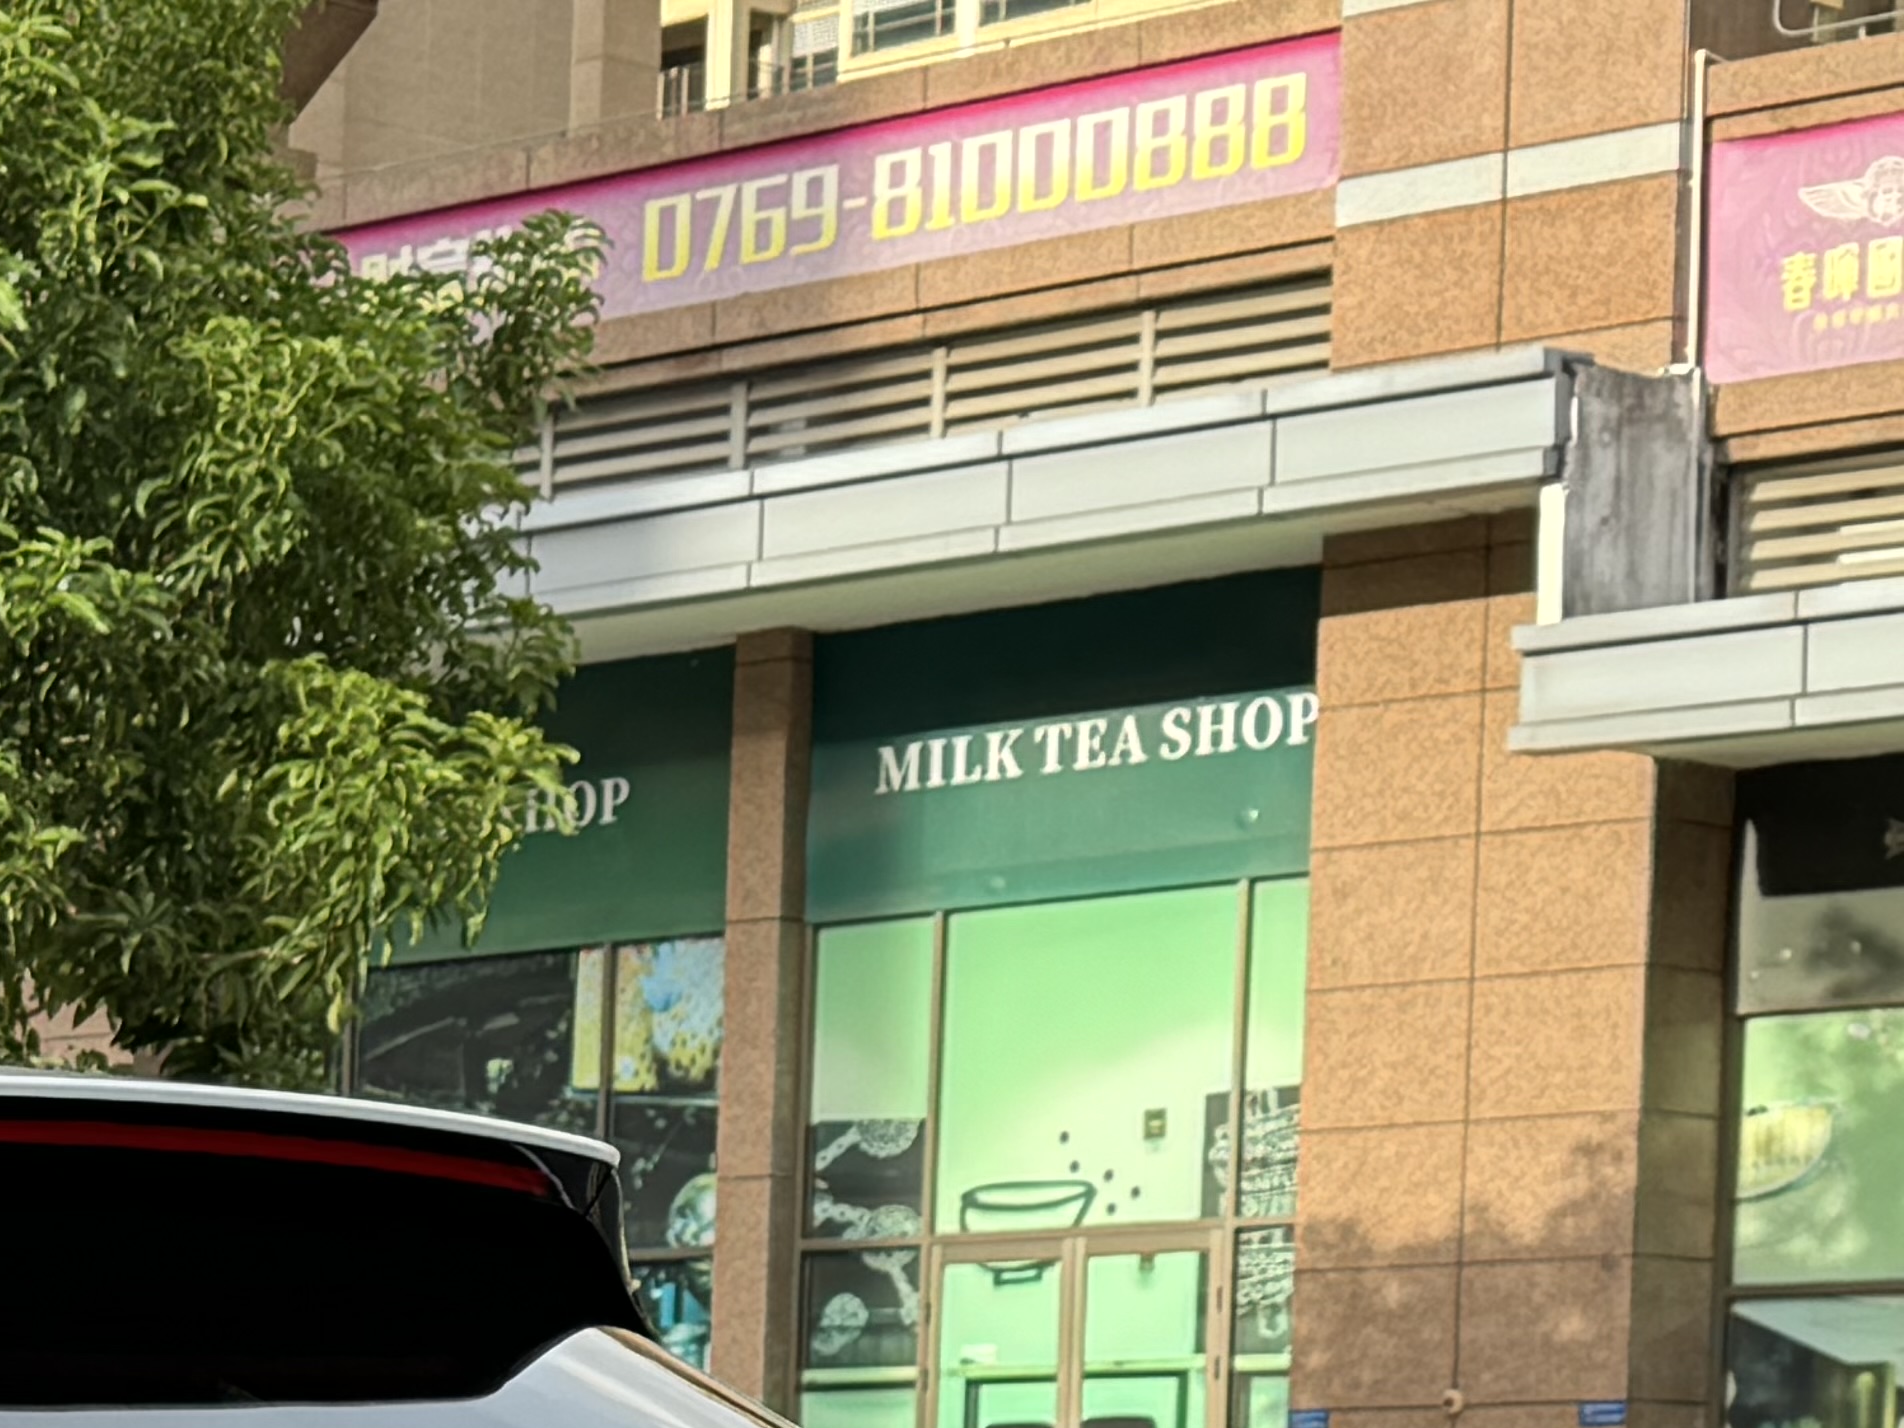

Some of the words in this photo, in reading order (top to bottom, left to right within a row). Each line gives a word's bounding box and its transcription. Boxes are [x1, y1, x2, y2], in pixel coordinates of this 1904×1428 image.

[641, 71, 1307, 282] 0769-81000888
[874, 728, 1024, 796] MILK
[1035, 715, 1145, 776] TEA
[1159, 692, 1319, 760] SHOP
[504, 777, 630, 834] HOP
